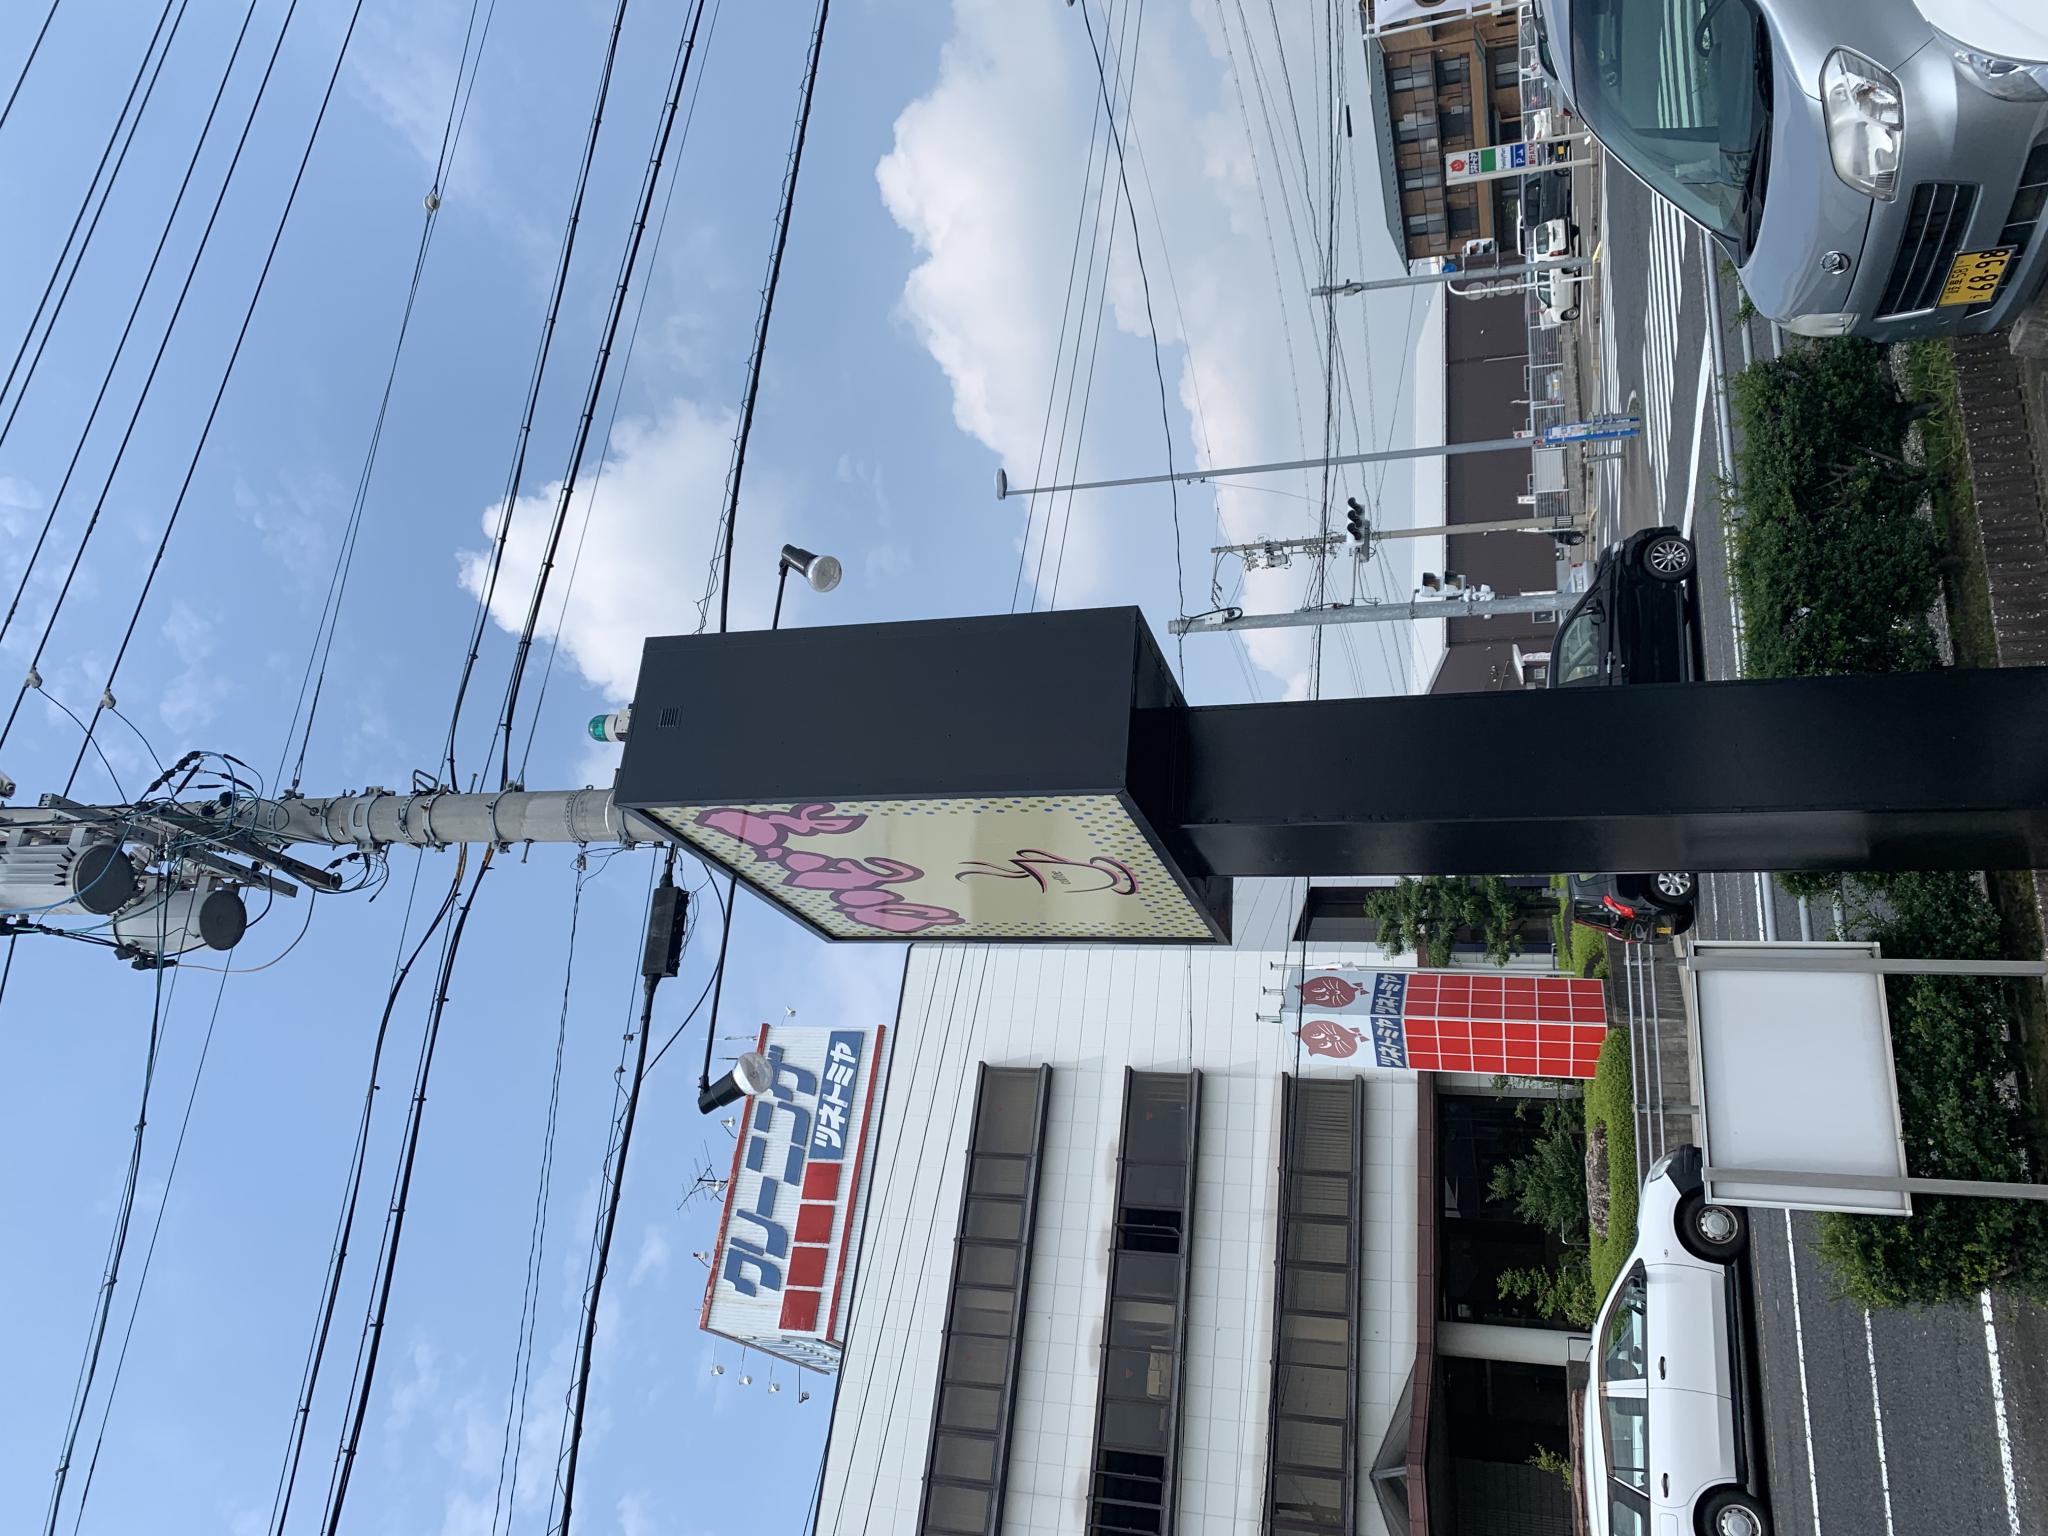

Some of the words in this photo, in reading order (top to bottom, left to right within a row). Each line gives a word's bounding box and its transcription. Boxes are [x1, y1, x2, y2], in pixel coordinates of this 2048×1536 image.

[1966, 249, 2009, 291] 68-98
[1375, 974, 1402, 1015] ツネトミヤ
[1375, 1018, 1404, 1067] ツネトミヤ
[814, 1042, 856, 1148] ツネトミヤ
[722, 1044, 817, 1298] クリーニング
